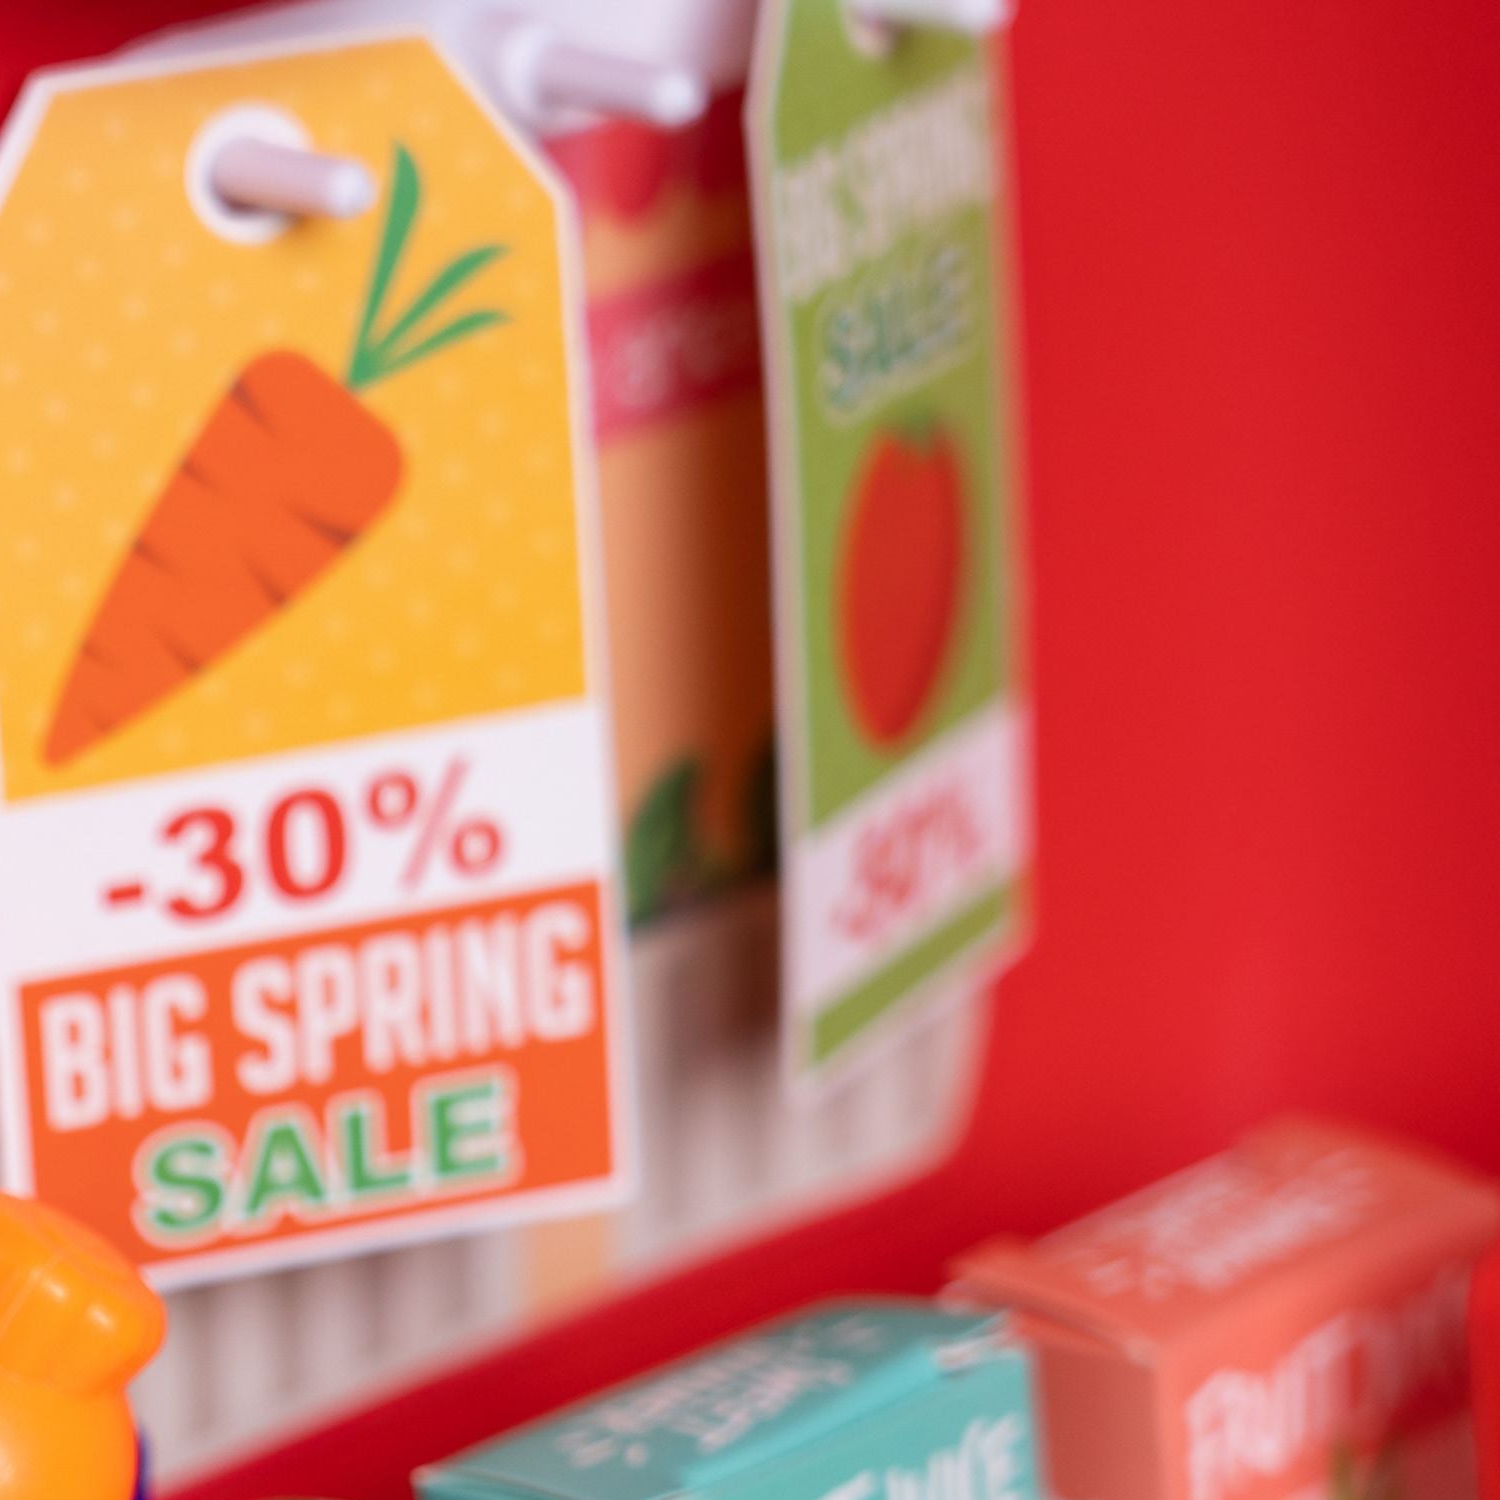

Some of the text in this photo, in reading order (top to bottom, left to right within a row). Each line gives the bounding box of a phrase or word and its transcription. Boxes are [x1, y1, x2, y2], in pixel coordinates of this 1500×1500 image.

[103, 757, 505, 922] -30%
[38, 899, 596, 1133] BIG SPRING
[142, 1072, 512, 1240] SALE
